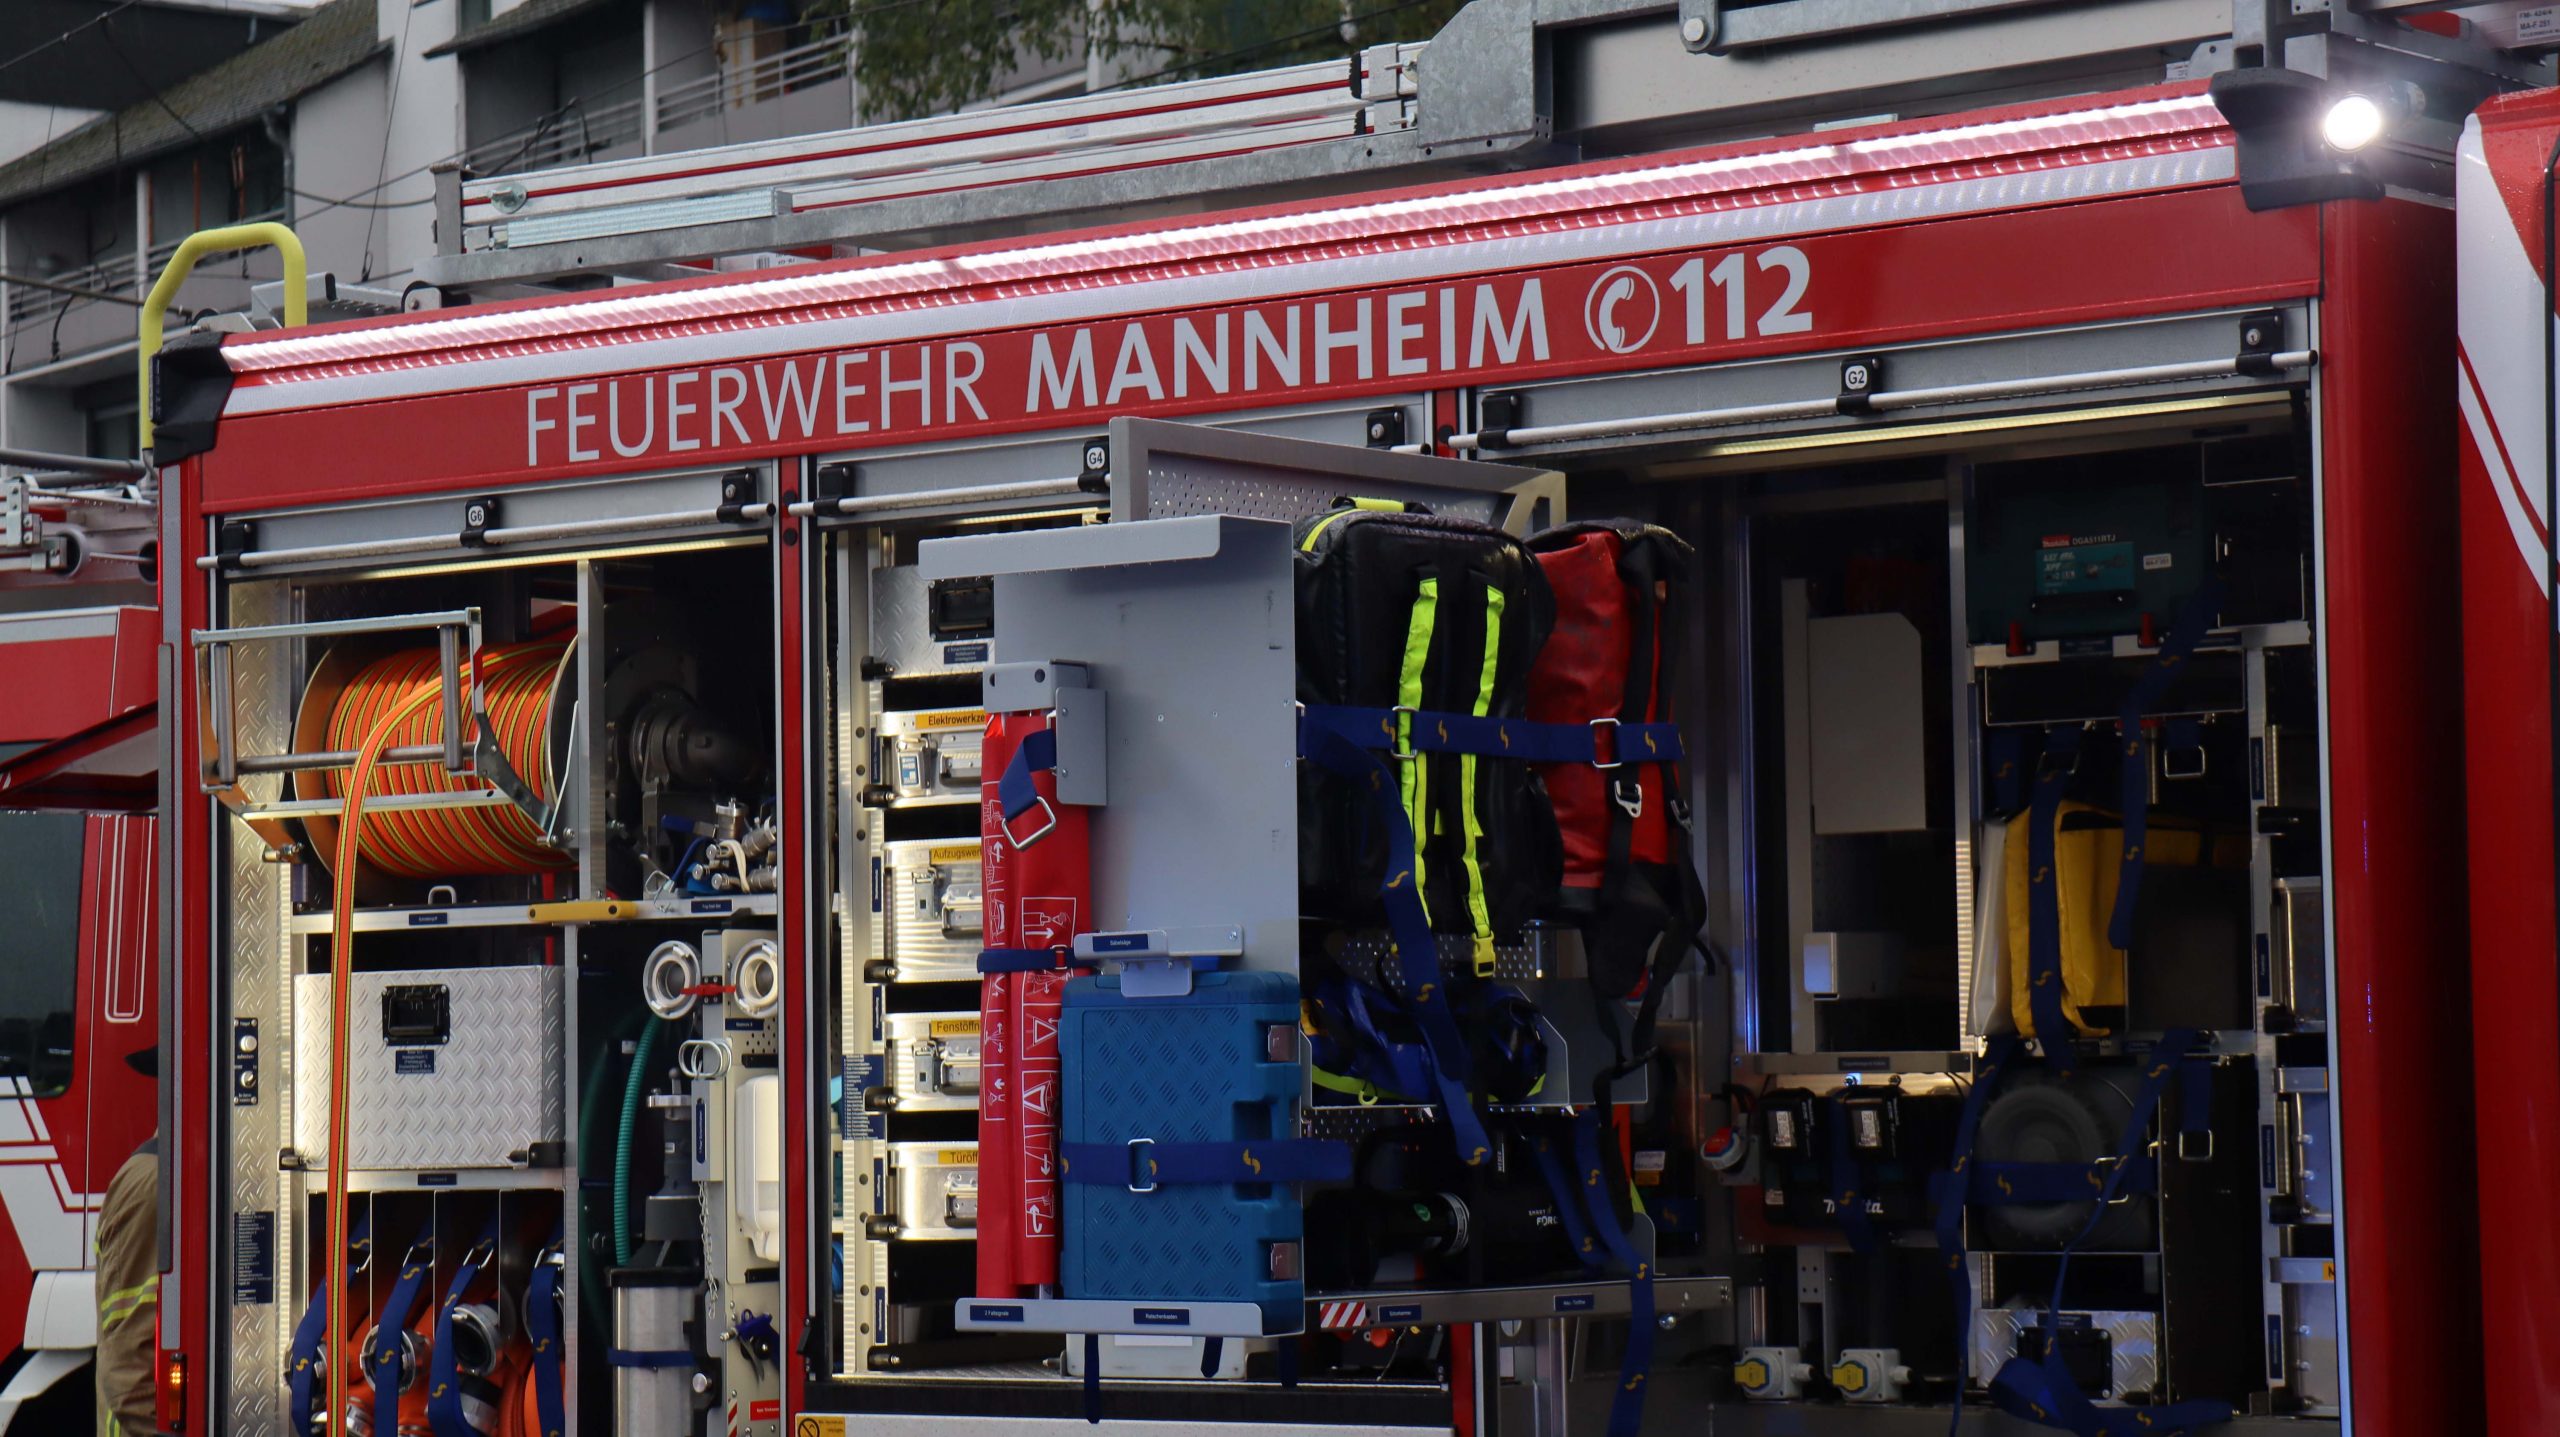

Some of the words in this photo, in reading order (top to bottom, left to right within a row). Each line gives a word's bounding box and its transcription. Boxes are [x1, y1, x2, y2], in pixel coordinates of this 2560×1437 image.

[527, 341, 989, 466] FEUERWEHR
[1026, 278, 1550, 413] MANNHEIM
[1669, 245, 1813, 345] 112
[1848, 369, 1865, 385] G2
[1089, 451, 1103, 465] G4
[470, 510, 483, 522] G6
